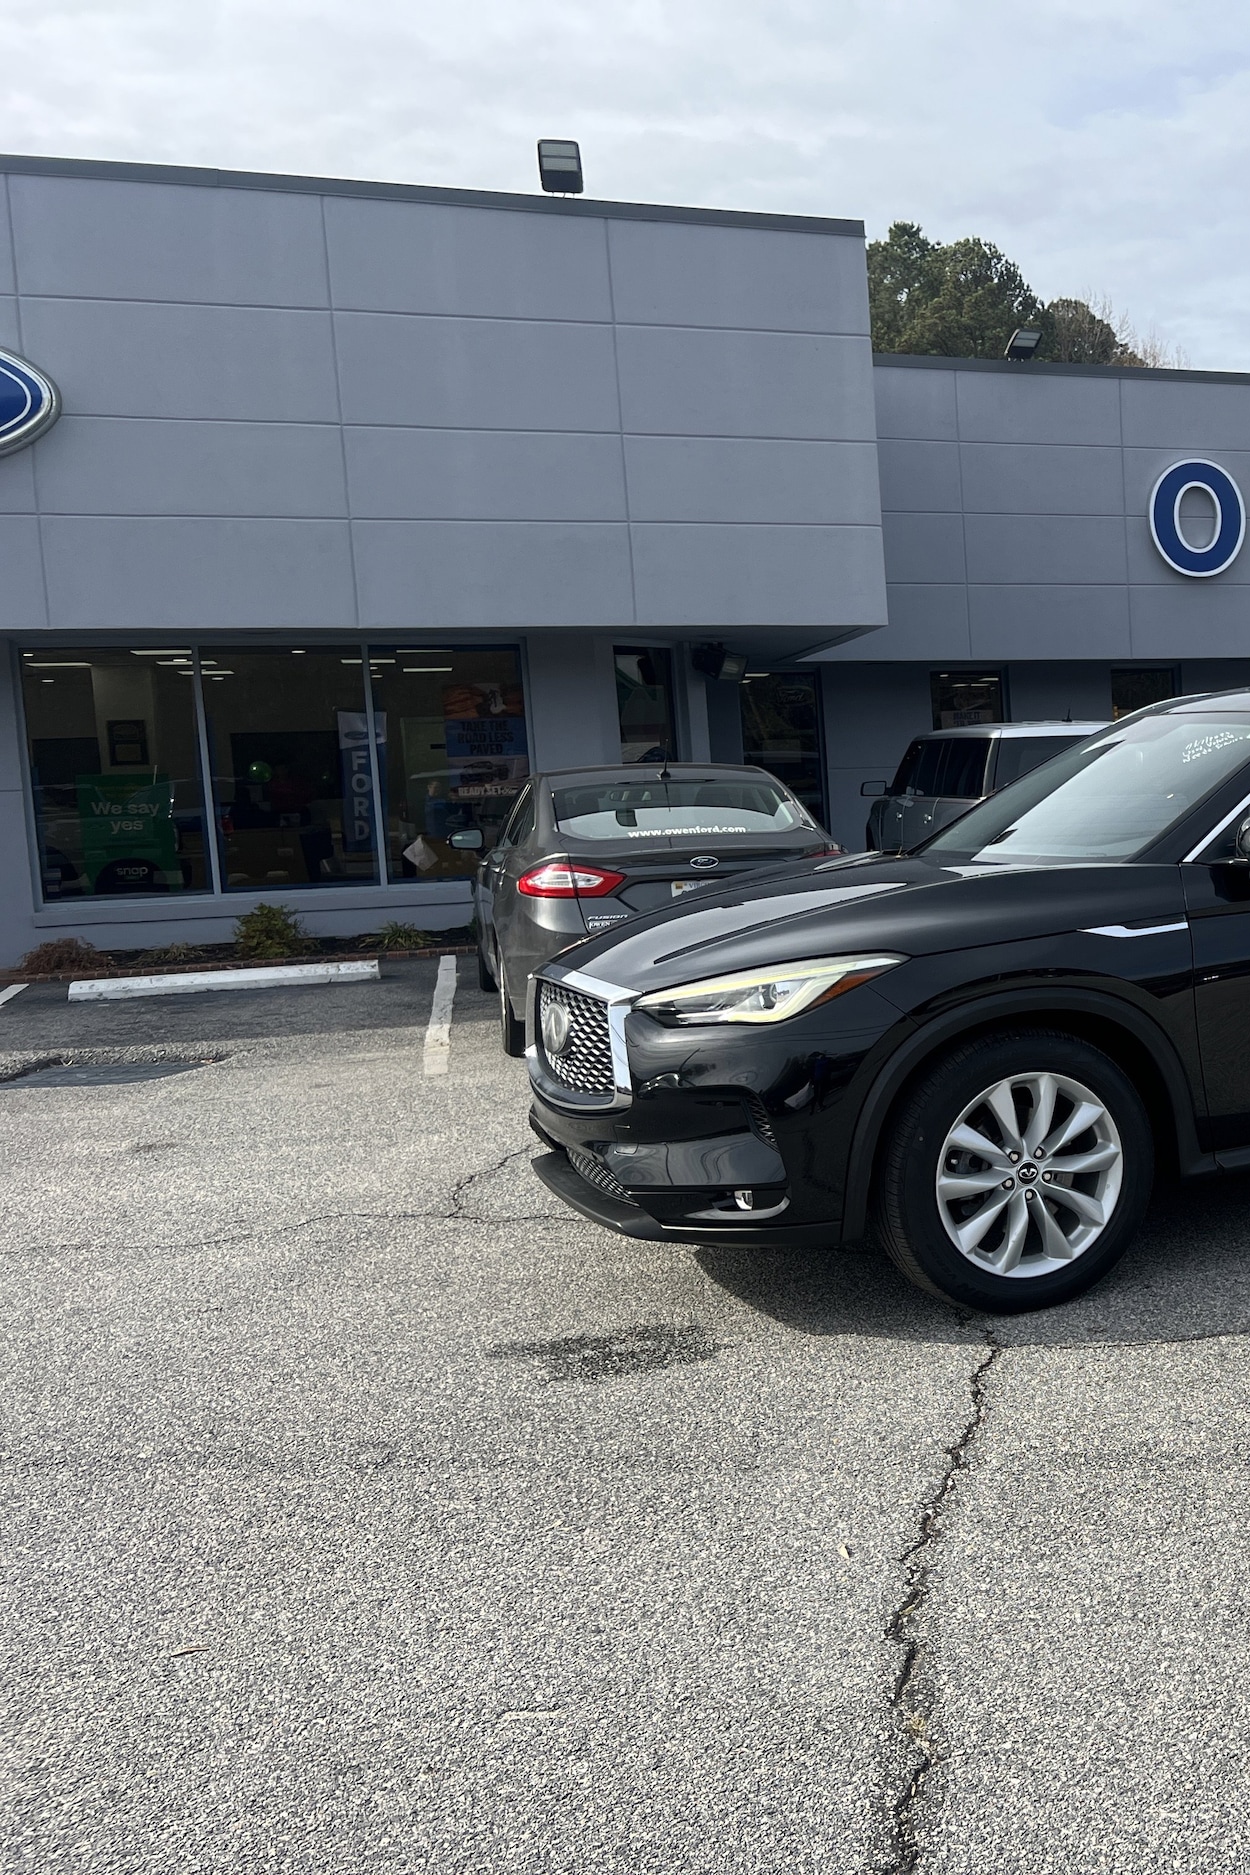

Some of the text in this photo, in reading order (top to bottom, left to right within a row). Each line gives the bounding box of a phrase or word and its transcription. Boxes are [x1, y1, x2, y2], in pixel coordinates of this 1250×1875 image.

[460, 720, 509, 732] TAKE THE
[458, 731, 514, 743] ROAD LESS
[470, 743, 503, 755] PAVED
[351, 750, 372, 841] FORD
[458, 786, 485, 796] READY
[91, 801, 160, 817] We say
[110, 820, 144, 835] yes
[628, 825, 746, 838] www.owenford.com
[116, 866, 149, 877] snap
